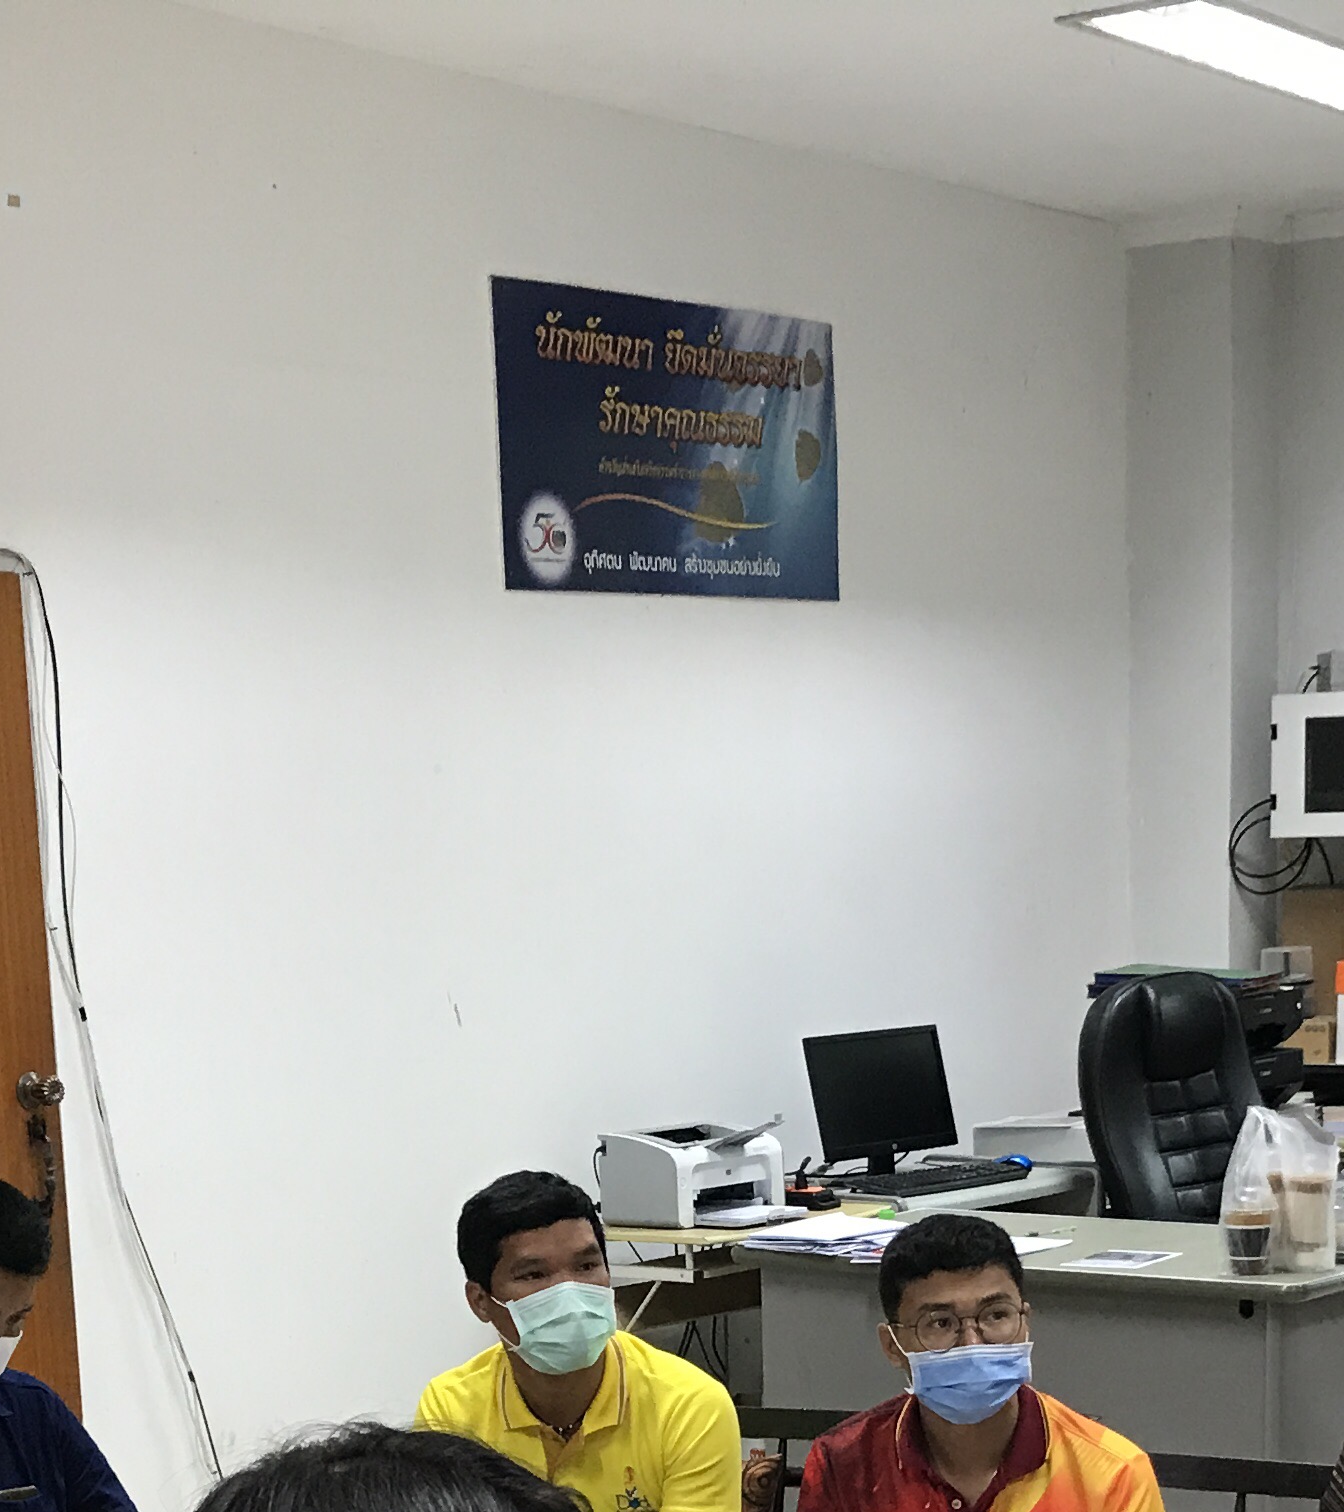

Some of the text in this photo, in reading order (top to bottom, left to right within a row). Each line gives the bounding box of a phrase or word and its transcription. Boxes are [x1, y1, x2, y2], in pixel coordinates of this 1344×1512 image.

[535, 310, 654, 370] นักพัฒนา
[598, 385, 764, 453] รักษาคุณธรรม
